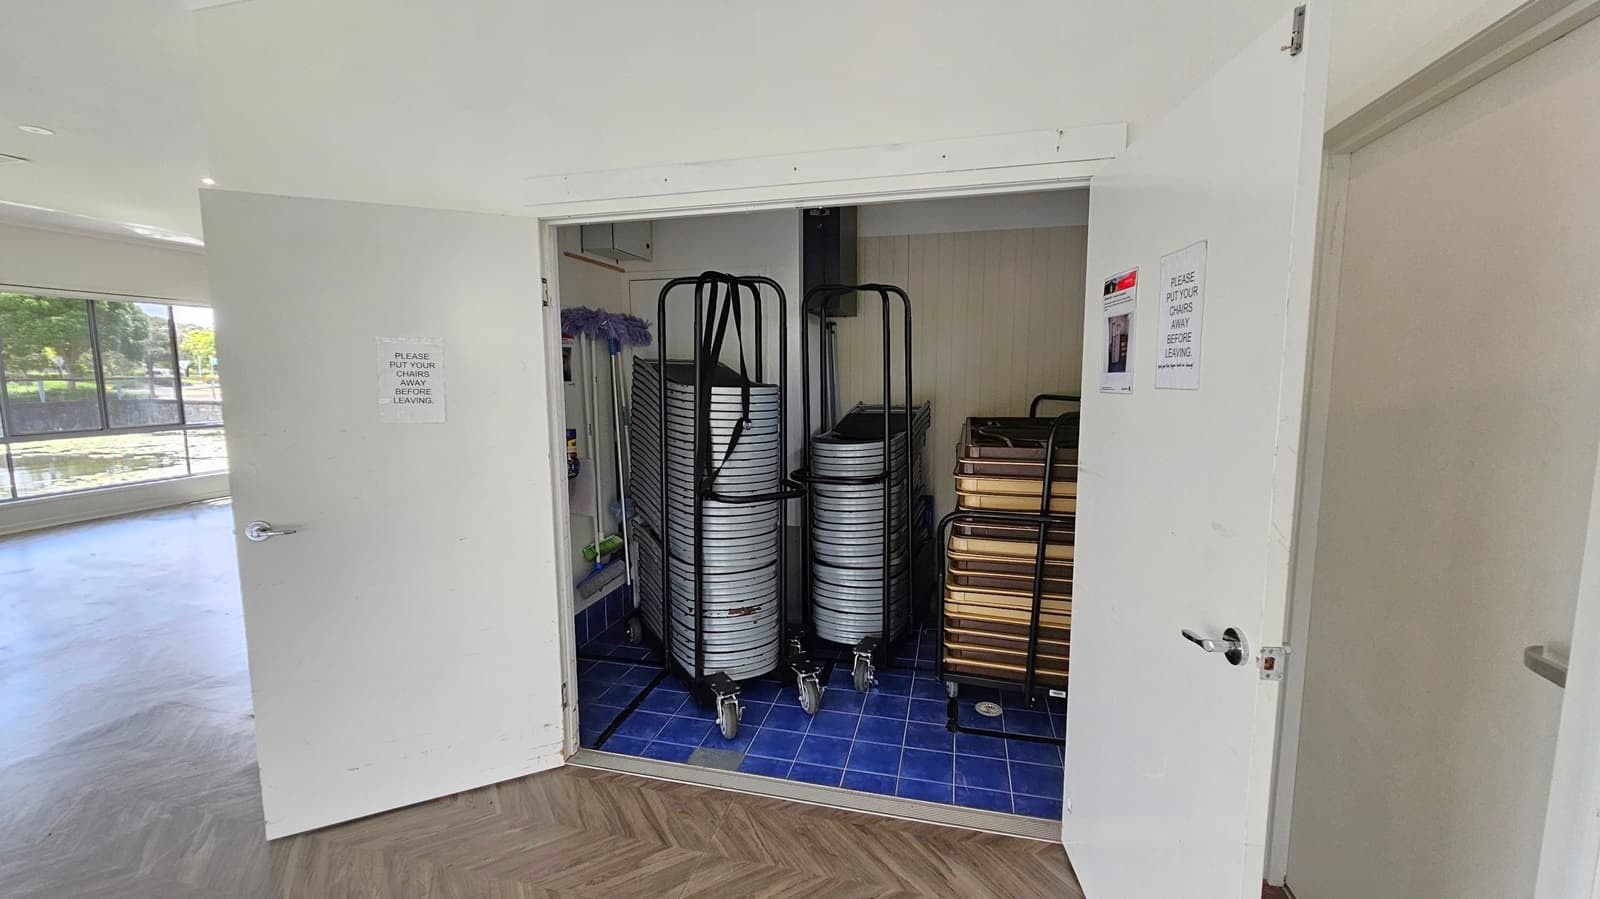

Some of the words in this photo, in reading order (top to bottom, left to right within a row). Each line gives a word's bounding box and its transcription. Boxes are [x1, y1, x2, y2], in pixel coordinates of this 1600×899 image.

[1170, 271, 1195, 288] PLEASE
[1166, 290, 1178, 303] PUT
[1179, 285, 1198, 300] YOUR
[1169, 302, 1193, 316] CHAIRS
[1170, 317, 1190, 330] AWAY
[1167, 332, 1192, 344] BEFORE
[1165, 346, 1192, 358] LEAVING.
